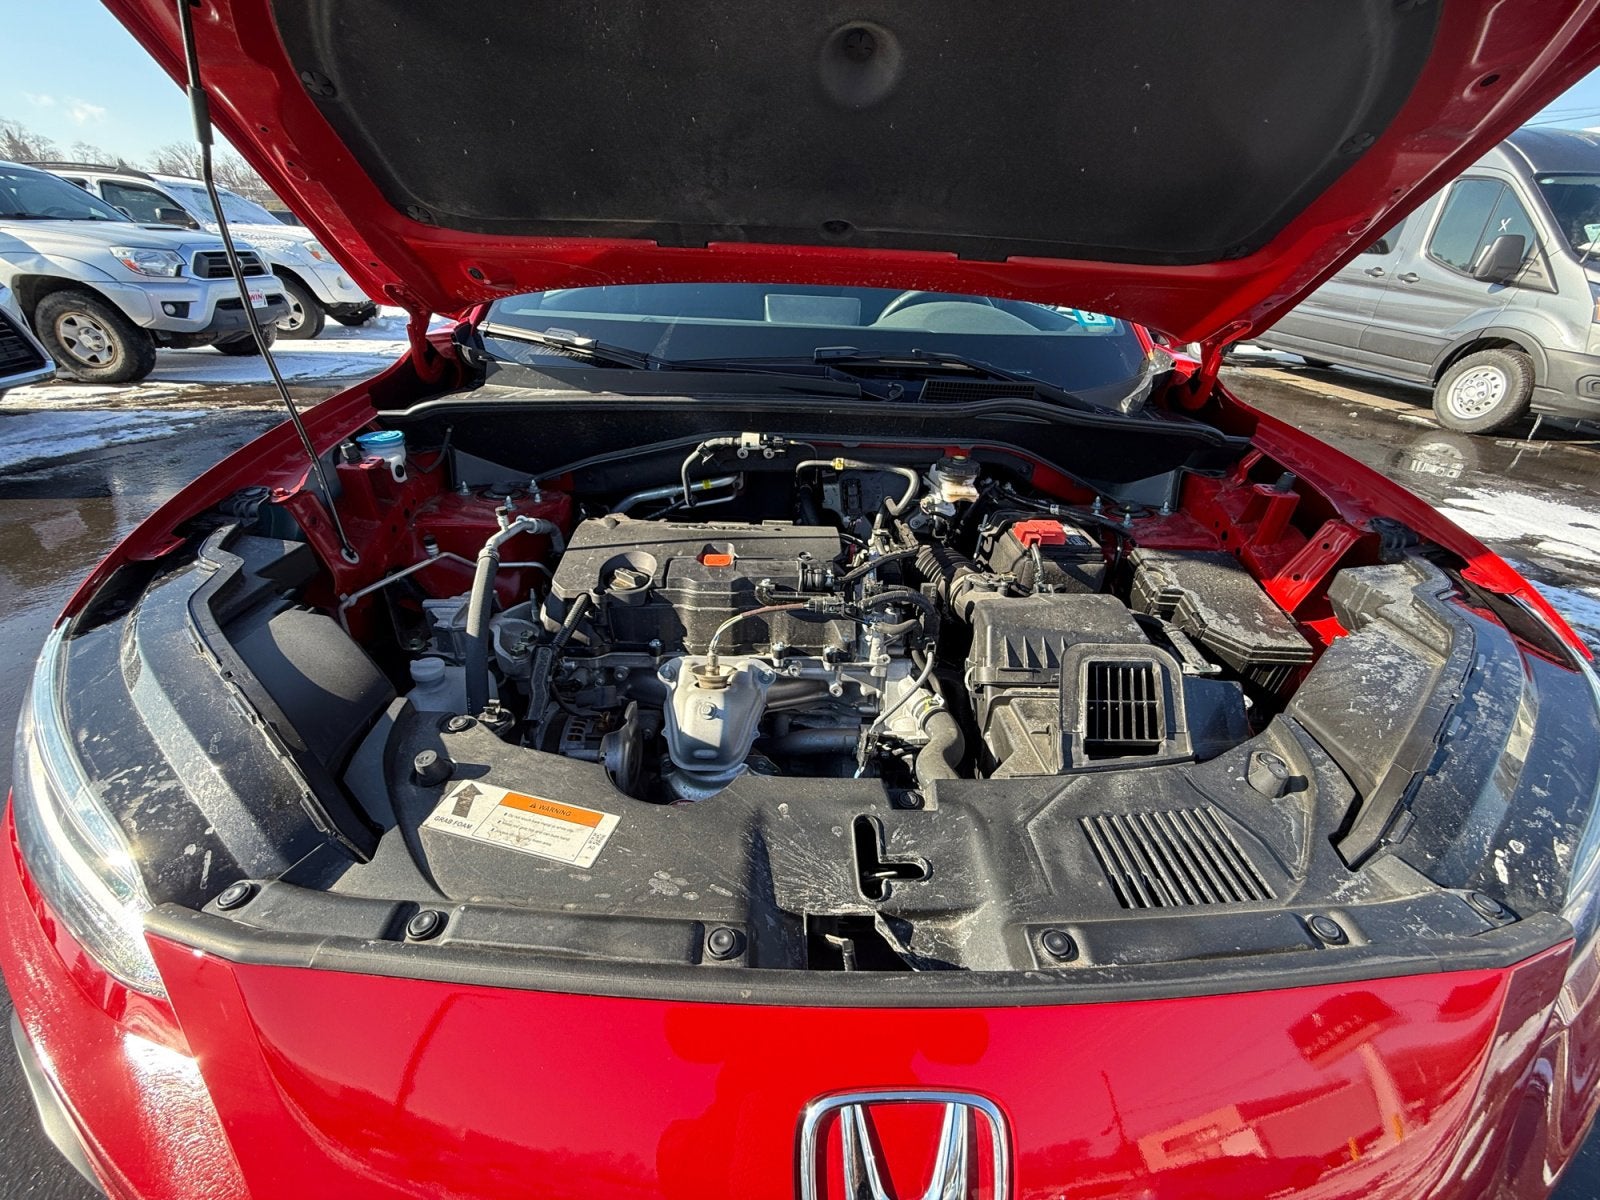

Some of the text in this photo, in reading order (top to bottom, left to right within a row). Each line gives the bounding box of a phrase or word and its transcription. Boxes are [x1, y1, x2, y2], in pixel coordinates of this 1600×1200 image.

[538, 804, 572, 817] WARNING
[433, 815, 474, 829] GRAB FOAM
